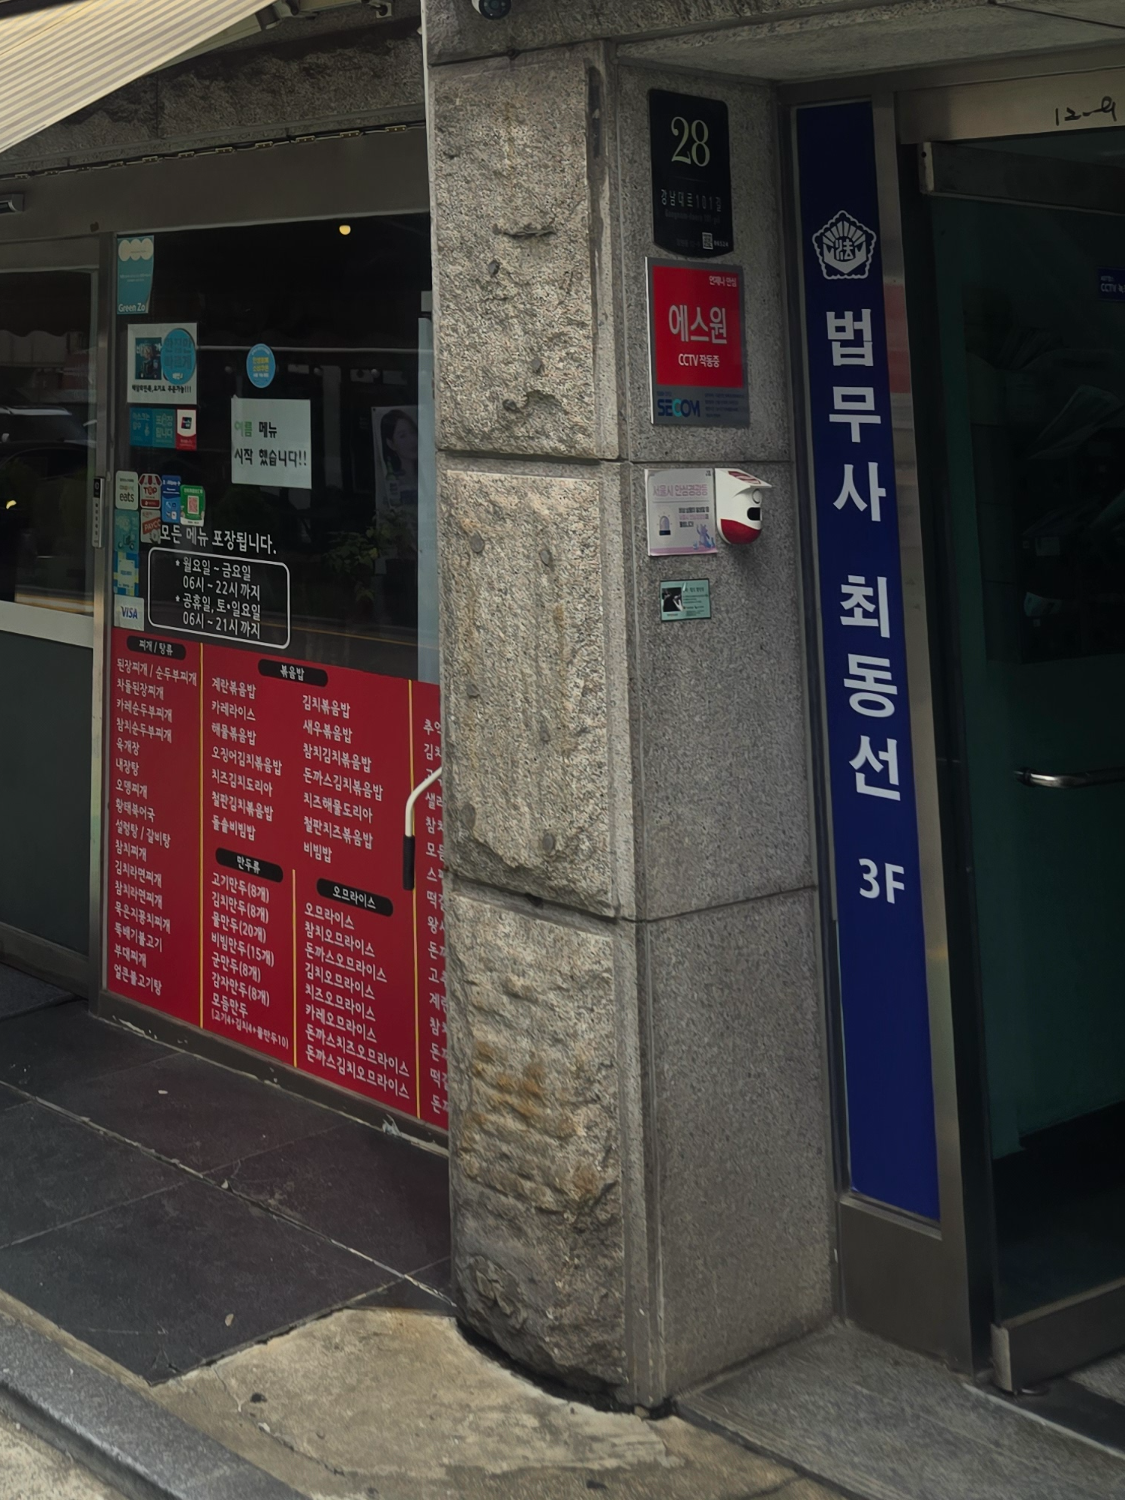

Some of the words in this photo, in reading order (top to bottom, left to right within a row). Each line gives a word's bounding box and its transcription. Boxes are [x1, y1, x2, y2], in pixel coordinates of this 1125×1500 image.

[671, 116, 711, 168] 28
[118, 303, 137, 313] Green
[668, 304, 727, 345] 에스원
[678, 353, 699, 367] CCTV
[698, 355, 721, 368] 작동중
[657, 398, 701, 418] SECOM
[826, 308, 887, 524] 법무사
[258, 421, 278, 439] 메뉴
[234, 447, 254, 466] 시작
[258, 448, 307, 468] 했습니다!!
[119, 491, 135, 504] eats
[160, 524, 182, 544] 모든
[186, 527, 209, 548] 메뉴
[212, 530, 277, 555] 포장됩니다.
[183, 557, 211, 576] 월요일
[221, 563, 251, 582] 금요일
[182, 575, 205, 593] 06시
[215, 580, 238, 598] 22시
[240, 584, 261, 602] 까지
[120, 605, 139, 620] VISA
[182, 612, 205, 630] 06시
[215, 617, 238, 635] 21시
[240, 621, 261, 640] 까지
[117, 658, 148, 677] 된장찌개
[155, 665, 197, 687] 순두부찌개
[280, 664, 305, 682] 볶음밥
[211, 677, 257, 700] 계란볶음밥
[839, 575, 902, 803] 최동선
[211, 700, 257, 721] 카레라이스
[302, 694, 351, 720] 김치볶음밥
[116, 716, 172, 744] 참치순두부찌개
[211, 722, 257, 746] 해물볶음밥
[302, 719, 353, 745] 새우볶음밥
[211, 746, 283, 777] 오징어김치볶음밥
[302, 742, 372, 774] 참치김치볶음밥
[211, 768, 273, 798] 치즈김치도리아
[303, 767, 384, 802] 돈까스김치볶음밥
[211, 790, 274, 822] 철판김치볶음밥
[303, 792, 373, 824] 치즈해물도리아
[211, 814, 256, 842] 돌솥비빔밥
[303, 815, 374, 850] 철판치즈볶음밥
[303, 841, 333, 864] 비빔밥
[211, 871, 270, 904] 고기만두(8개)
[858, 856, 906, 905] 3F
[211, 891, 269, 924] 김치만두(8개)
[332, 885, 377, 910] 오므라이스
[211, 911, 267, 944] 물만두(20개)
[304, 902, 355, 930] 오므라이스
[211, 931, 275, 968] 비빔만두(15개)
[304, 921, 375, 958] 참치오므라이스
[211, 951, 261, 984] 군만두(8개)
[304, 942, 388, 983] 돈까스오므라이스
[304, 962, 375, 1000] 김치오므라이스
[305, 982, 376, 1022] 치즈오므라이스
[305, 1003, 377, 1043] 카레오므라이스
[305, 1023, 410, 1078] 돈까스치즈오므라이스
[305, 1044, 410, 1100] 돈까스김치오므라이스
